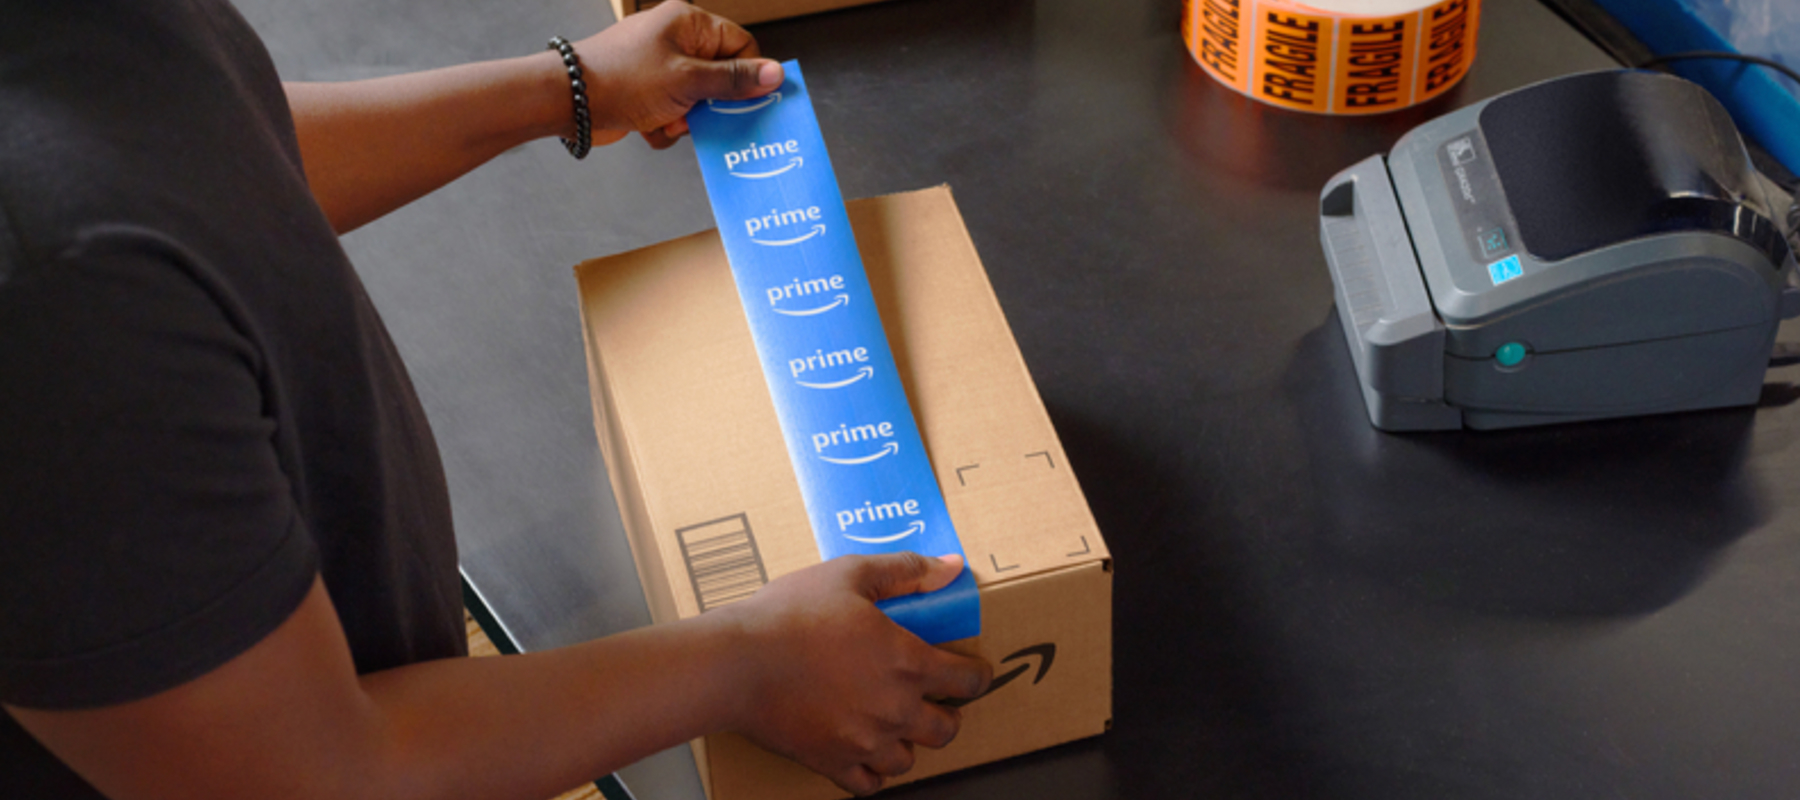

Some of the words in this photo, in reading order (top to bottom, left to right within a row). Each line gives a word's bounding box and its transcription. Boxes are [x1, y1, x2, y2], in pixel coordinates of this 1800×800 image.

[1264, 12, 1318, 105] FRAGILE
[1346, 20, 1404, 107] FRAGILE
[724, 139, 799, 170] prime
[745, 206, 822, 237] prime
[766, 275, 845, 306] prime
[788, 347, 869, 378] prime
[811, 422, 893, 453] prime
[836, 499, 920, 532] prime
